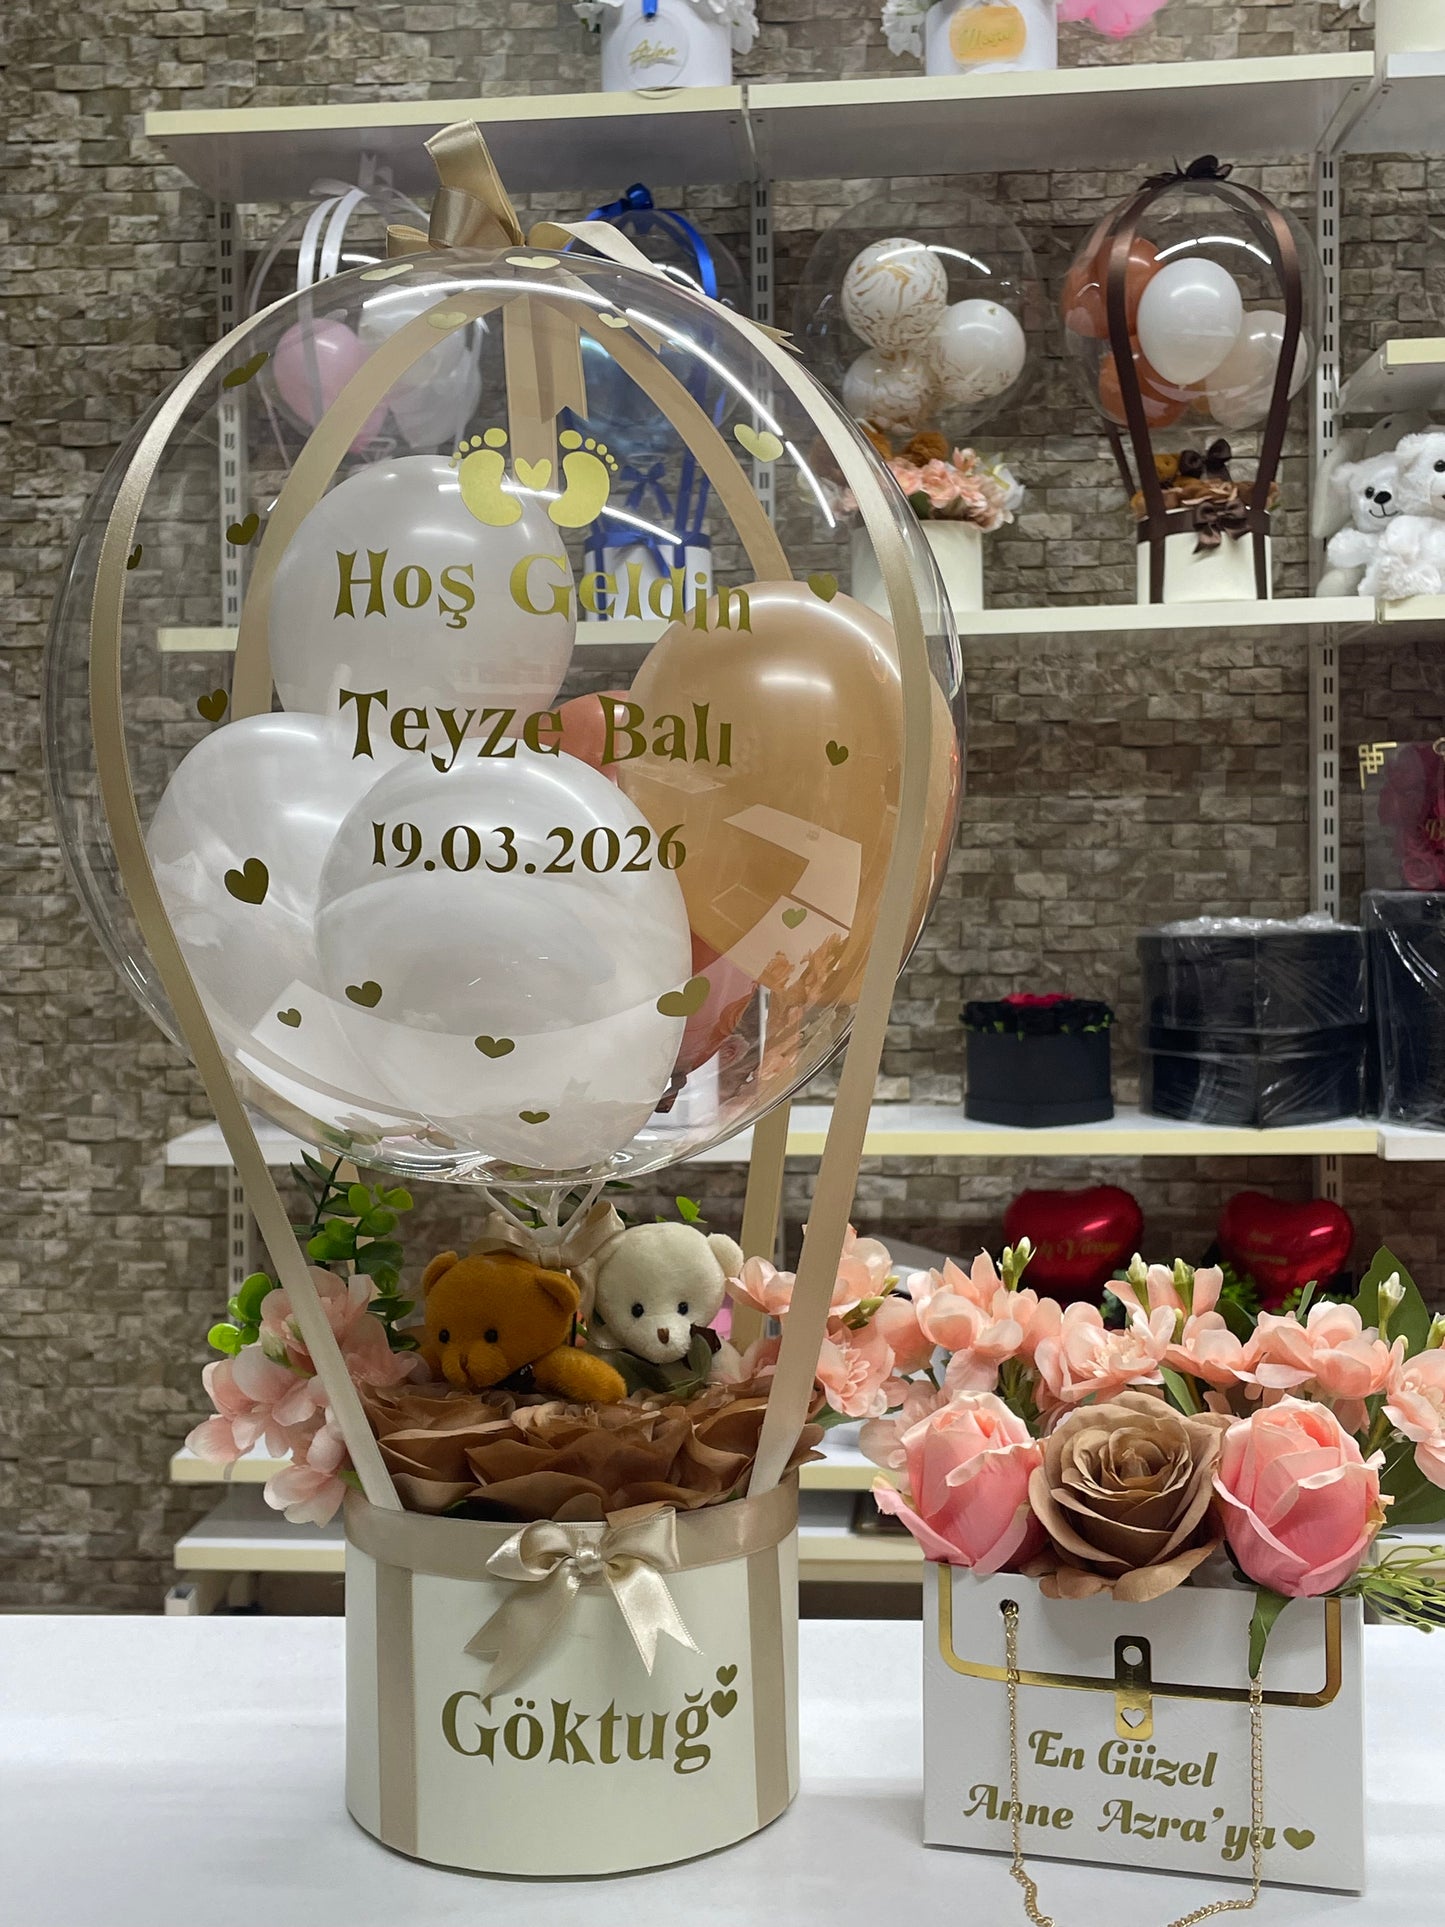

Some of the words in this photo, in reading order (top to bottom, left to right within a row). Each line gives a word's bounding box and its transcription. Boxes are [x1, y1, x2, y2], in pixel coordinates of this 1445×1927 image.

[333, 548, 476, 629] Hoş
[509, 552, 753, 634] Geldin
[339, 688, 563, 773] Teyze
[597, 694, 733, 768] Balı
[371, 821, 687, 874] 19.03.2026
[441, 1688, 711, 1775] Göktuğ
[1028, 1729, 1086, 1770] En
[1098, 1739, 1218, 1787] Güzel
[963, 1783, 1073, 1831] Anne
